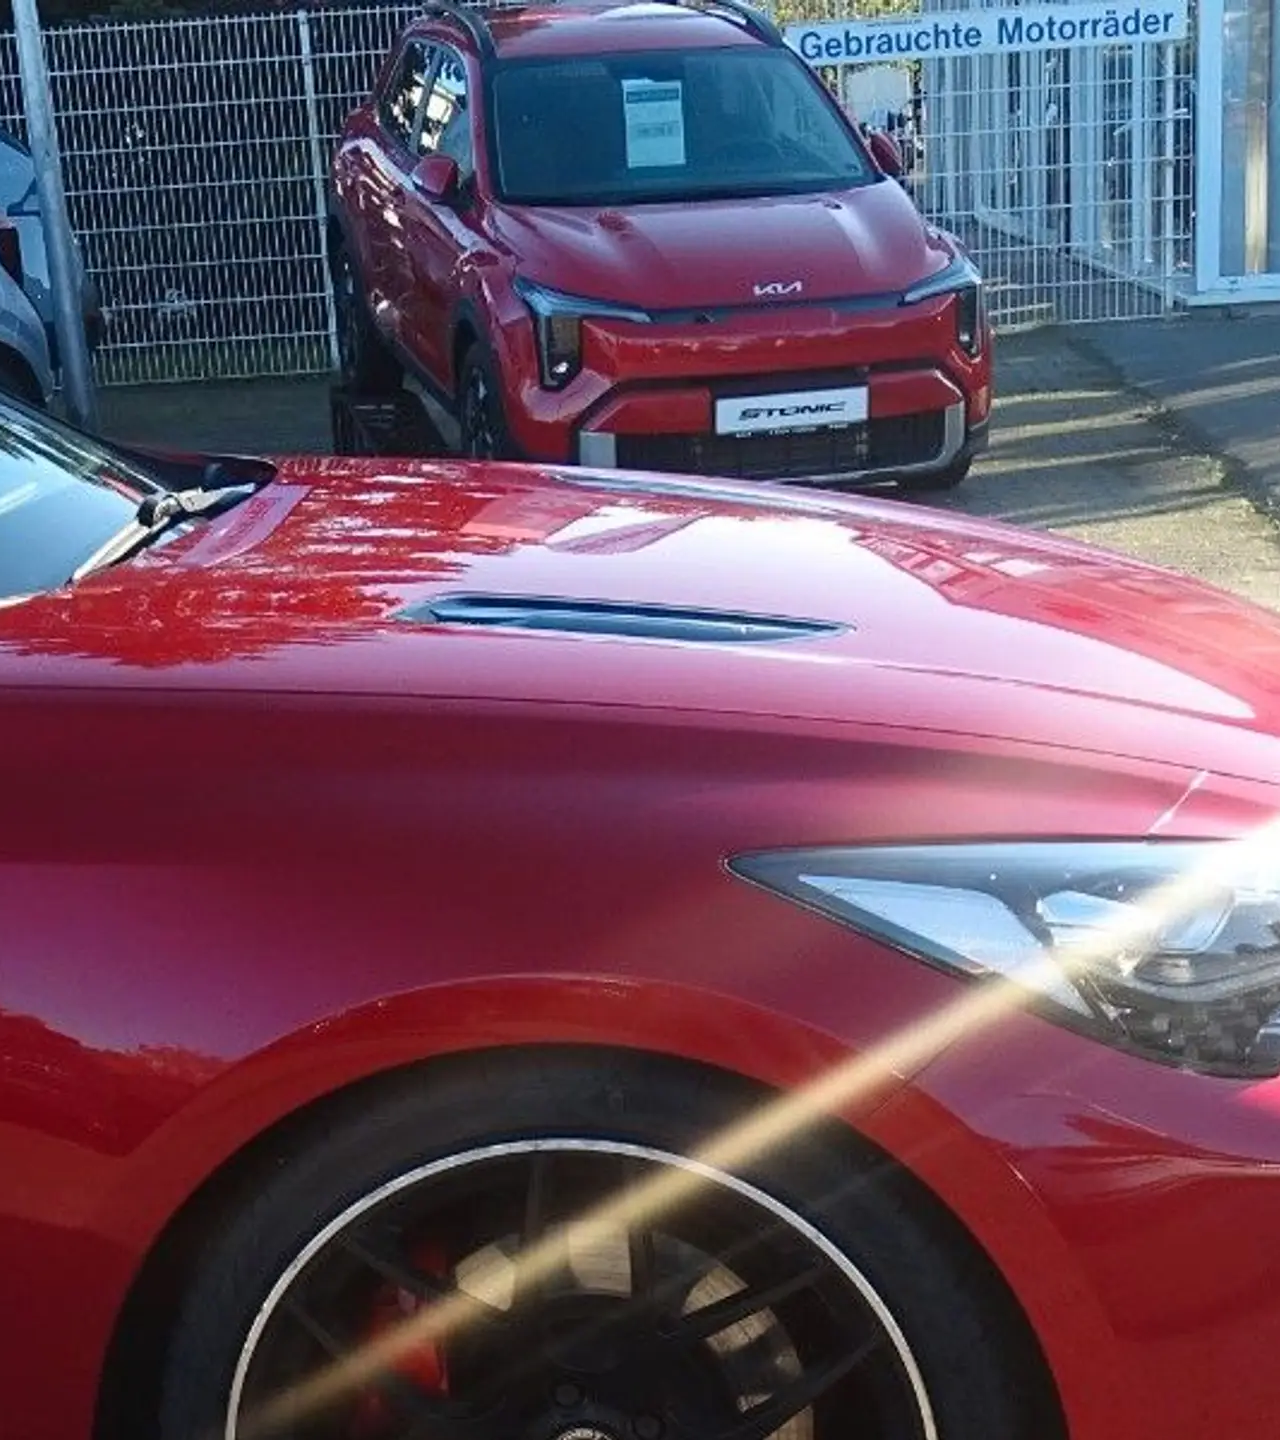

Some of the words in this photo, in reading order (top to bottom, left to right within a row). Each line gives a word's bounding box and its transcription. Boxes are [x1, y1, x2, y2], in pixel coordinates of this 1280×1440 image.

[800, 22, 982, 60] Gebrauchte
[997, 8, 1174, 45] Motorräder
[753, 280, 802, 296] KIA
[739, 401, 847, 421] STONIC
